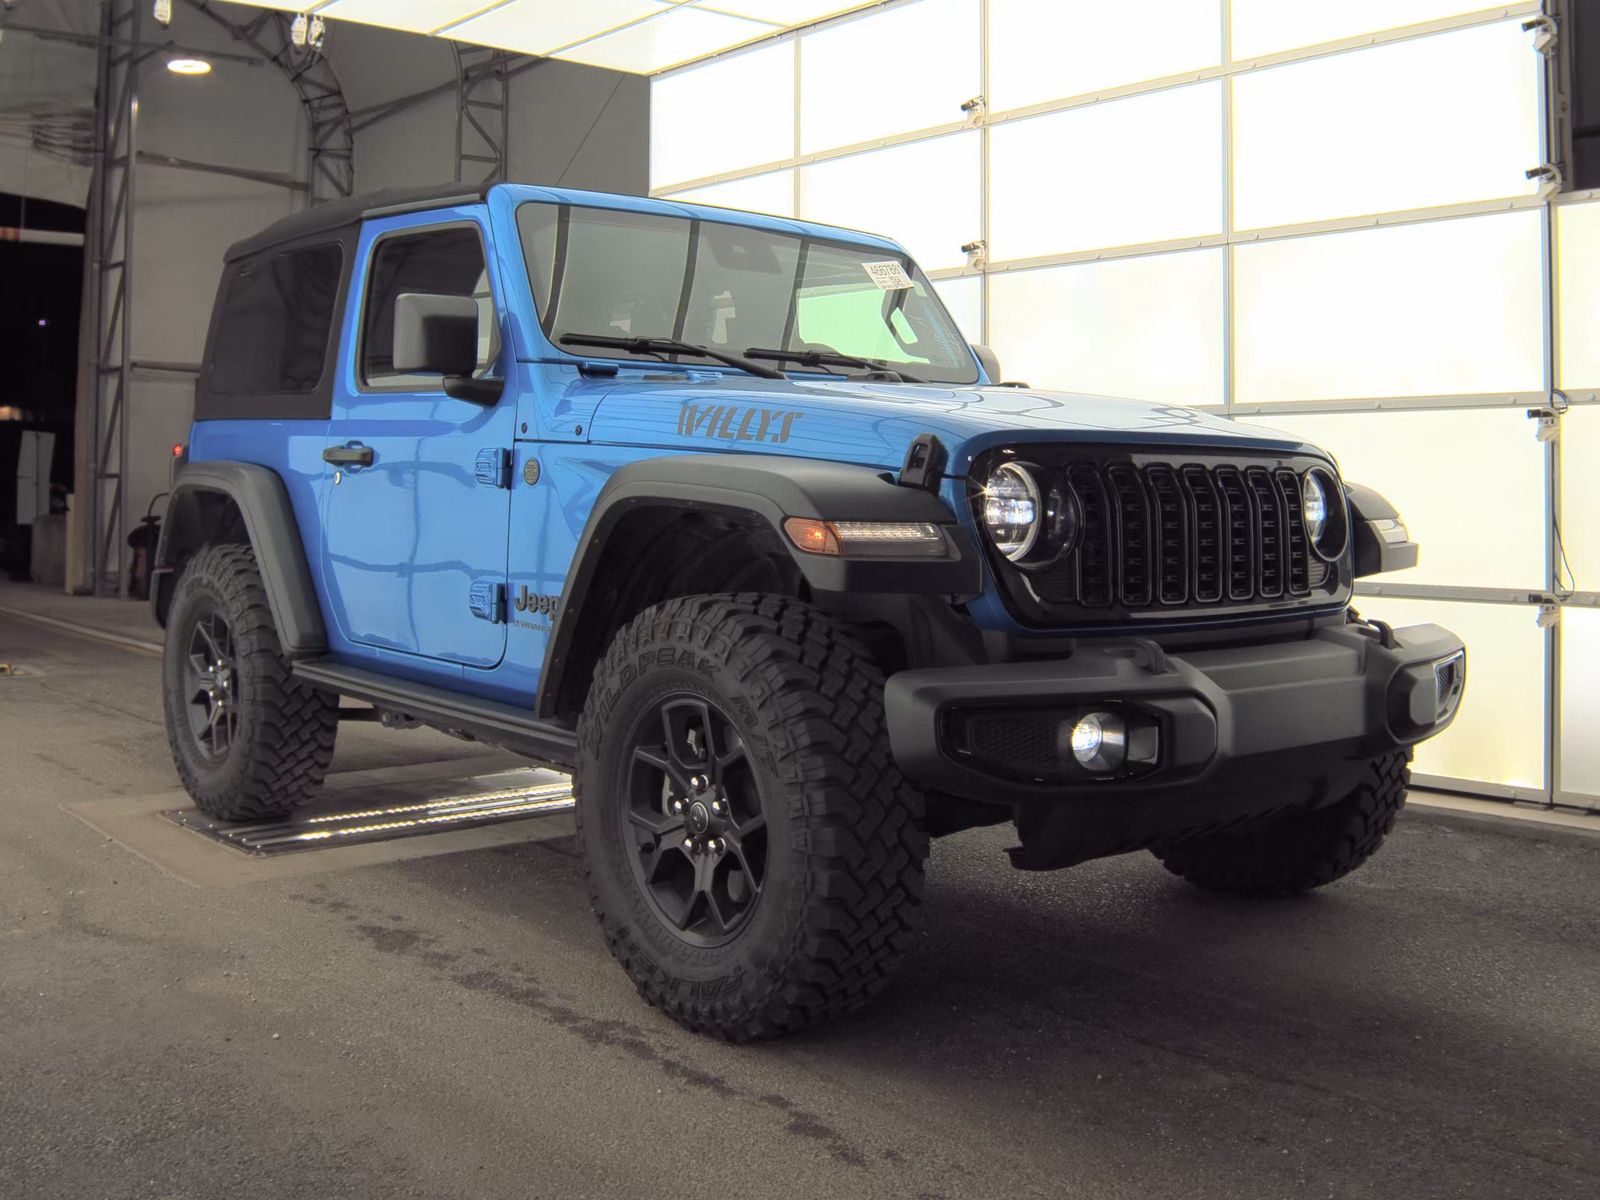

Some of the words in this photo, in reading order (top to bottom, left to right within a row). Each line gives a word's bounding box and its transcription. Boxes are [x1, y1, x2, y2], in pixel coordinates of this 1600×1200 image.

[677, 404, 803, 443] WILLYS
[514, 585, 560, 621] Jeep
[583, 647, 721, 760] WILDPEAK
